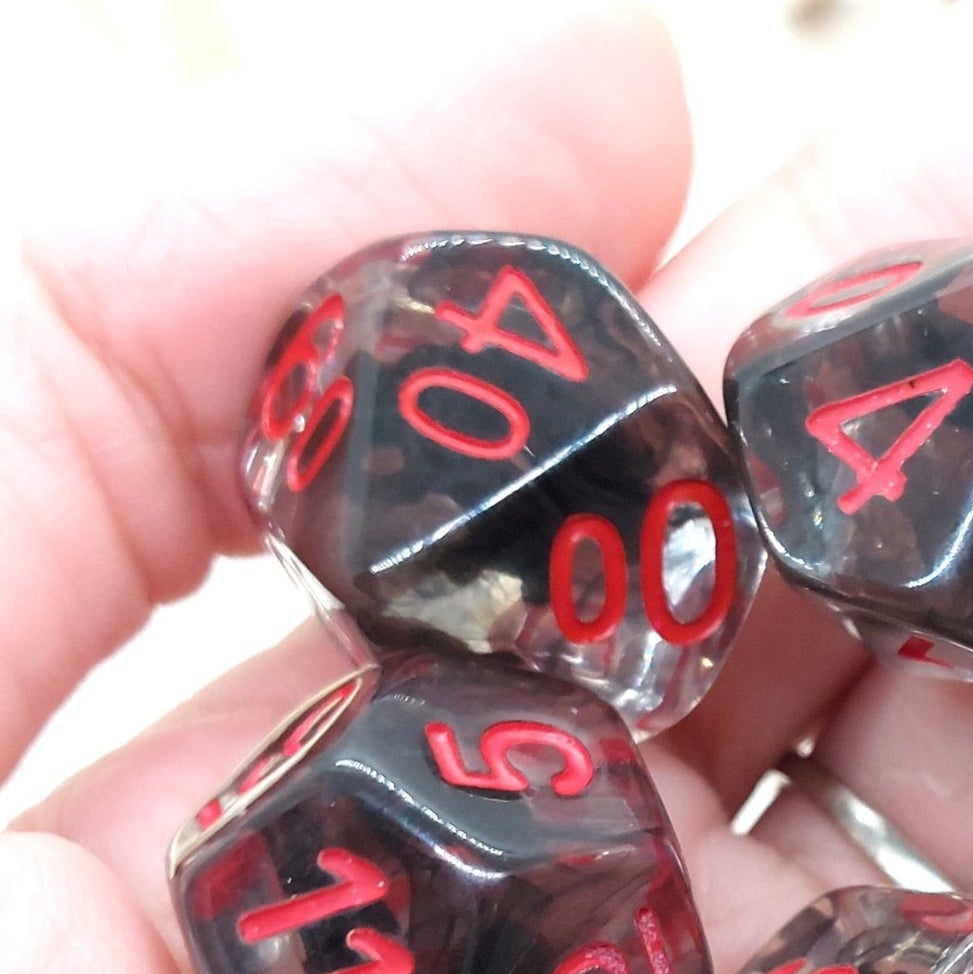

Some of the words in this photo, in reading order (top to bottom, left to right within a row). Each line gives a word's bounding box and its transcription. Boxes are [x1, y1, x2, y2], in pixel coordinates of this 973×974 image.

[398, 265, 589, 460] 40
[549, 478, 736, 646] 00
[424, 719, 594, 796] 5
